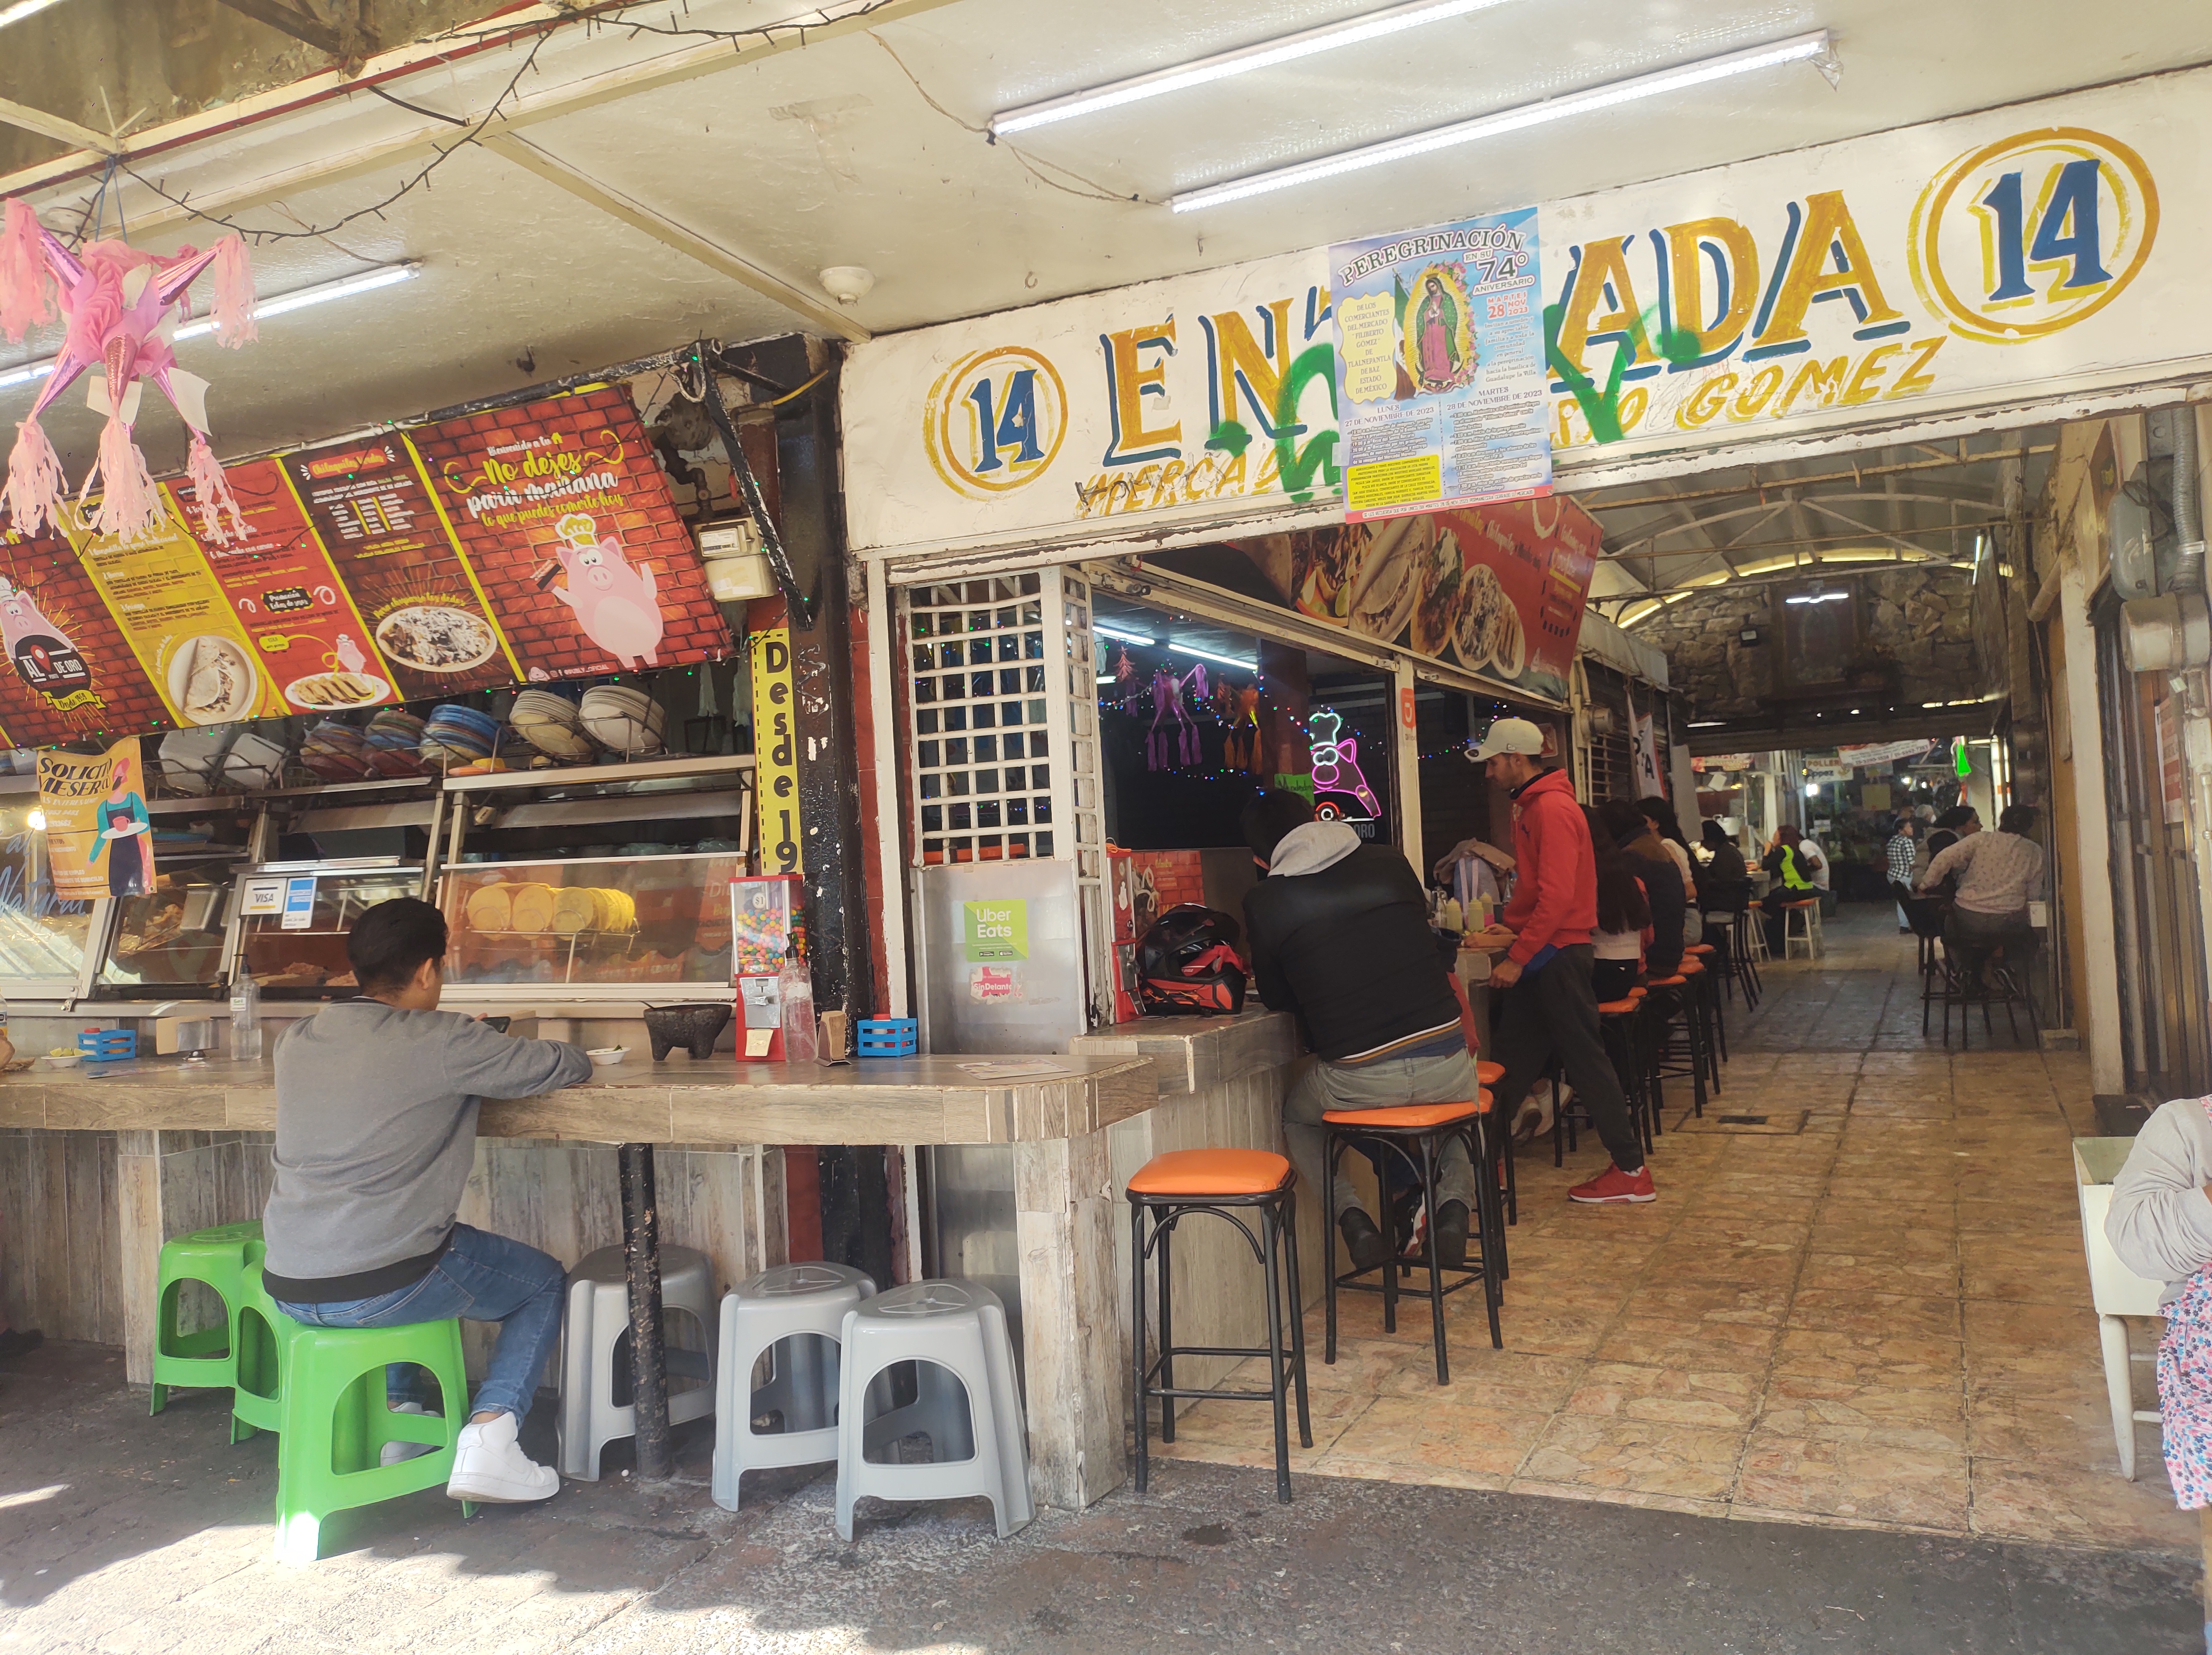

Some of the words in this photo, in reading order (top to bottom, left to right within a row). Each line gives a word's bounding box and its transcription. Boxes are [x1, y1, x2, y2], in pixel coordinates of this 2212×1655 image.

[1983, 159, 2114, 301] 14
[1340, 225, 1525, 285] PEREGRINACIÓN
[1475, 277, 1533, 293] ANIVERSARIO
[1488, 292, 1526, 303] MARTES
[1488, 305, 1505, 318] 28
[1508, 299, 1526, 307] NOV
[1508, 306, 1528, 315] 2023
[1344, 309, 1390, 323] COMERCIANTES
[1359, 318, 1388, 329] MERCADO
[1494, 340, 1525, 350] comunidad
[1348, 355, 1391, 368] TLALNEPANTLA
[1369, 366, 1380, 374] BAZ
[1360, 375, 1382, 384] ESTADO
[1485, 373, 1515, 382] Guadalupe
[1676, 335, 1947, 430] GOMEZ
[1364, 383, 1387, 393] MÉXICO
[1479, 387, 1509, 396] MARTES
[1468, 395, 1511, 407] NOVIEMBRE
[1524, 389, 1542, 398] 2023
[1364, 412, 1404, 424] NOVIEMBRE
[1416, 407, 1434, 415] 2023
[1377, 405, 1399, 413] LUNES
[970, 369, 1046, 472] 14
[312, 458, 358, 475] Chilaquiles
[482, 458, 518, 485] No
[523, 450, 582, 481] dejes
[466, 490, 522, 519] para
[481, 512, 495, 527] lo
[496, 512, 517, 529] que
[517, 502, 555, 525] puedes
[555, 494, 599, 513] comerte
[598, 491, 624, 507] hoy
[22, 659, 46, 678] AL
[53, 662, 67, 674] DE
[65, 659, 82, 673] ORO
[766, 641, 793, 798] Desde
[1353, 823, 1375, 838] ORO
[255, 893, 274, 902] VISA
[755, 897, 763, 905] $1
[977, 908, 1012, 922] Uber
[977, 924, 1012, 938] Eats
